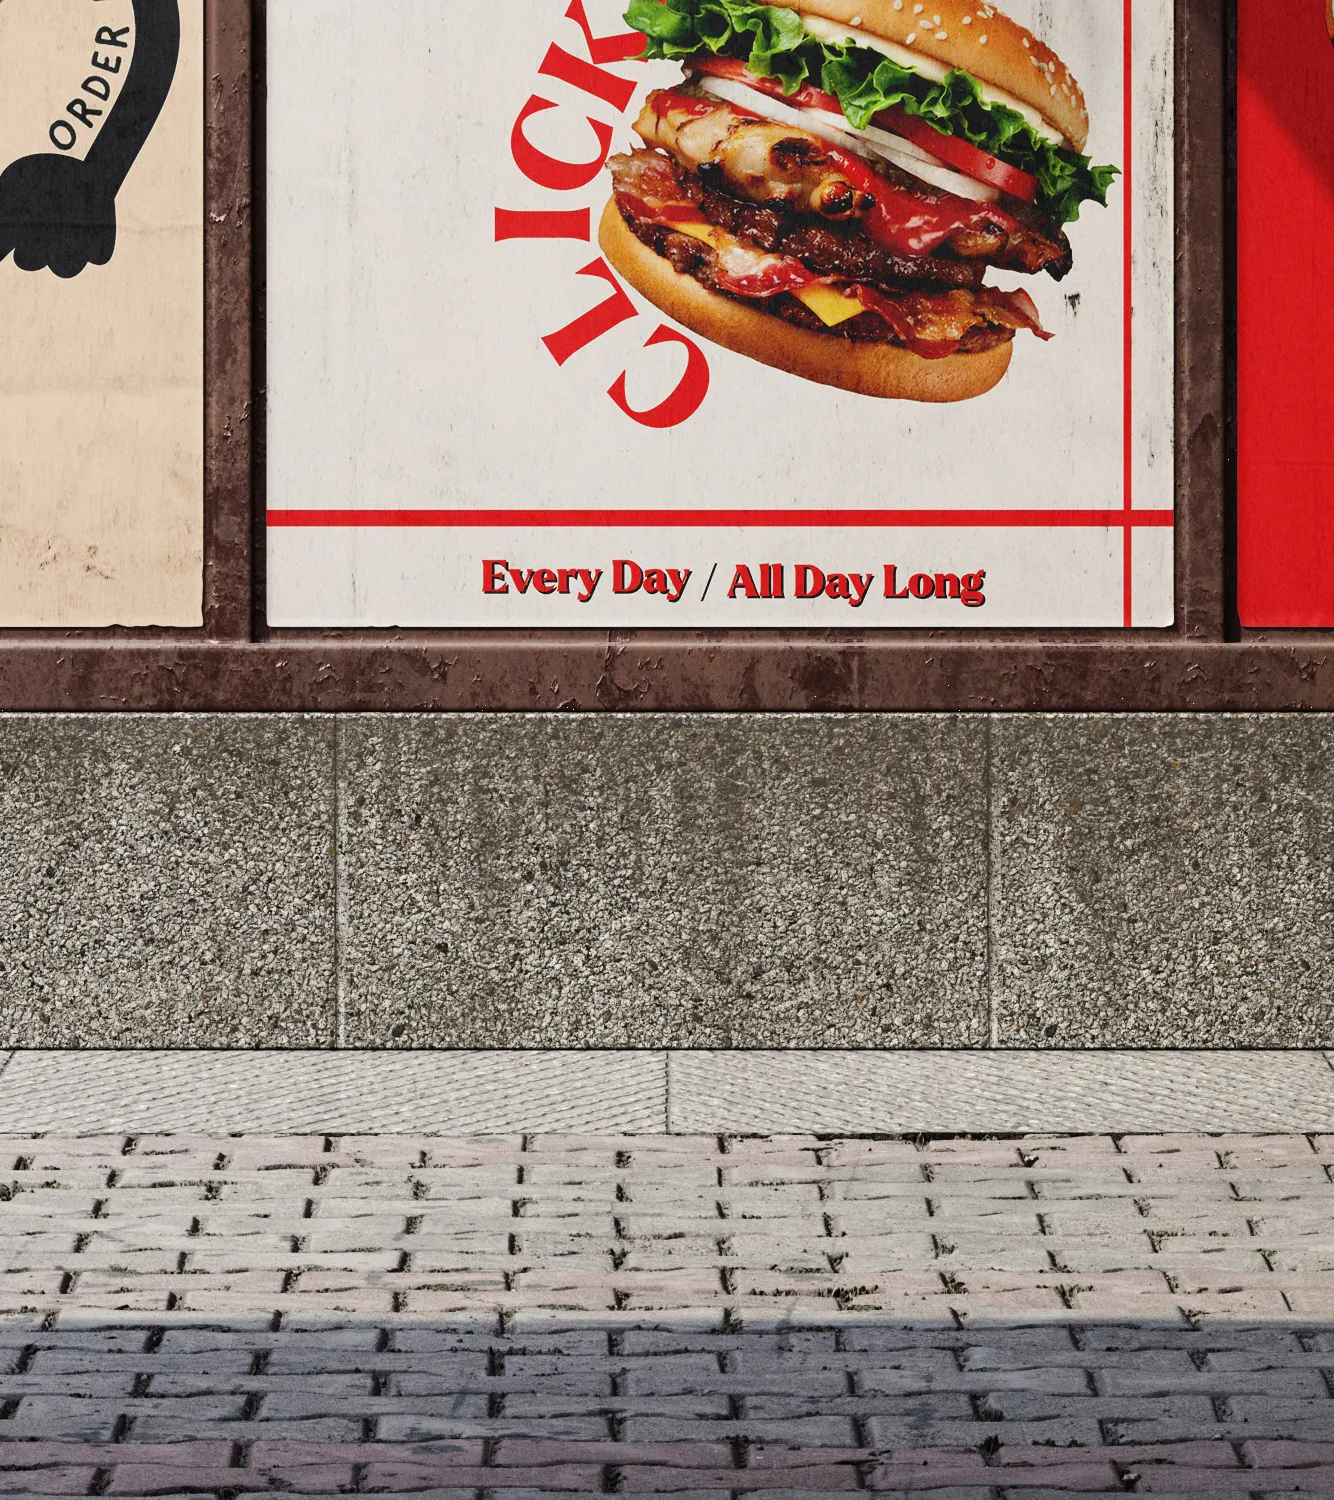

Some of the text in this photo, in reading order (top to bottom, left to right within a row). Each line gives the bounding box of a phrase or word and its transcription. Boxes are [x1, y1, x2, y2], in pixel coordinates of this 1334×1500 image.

[49, 26, 130, 151] ORDER
[481, 559, 603, 603] Every
[612, 559, 693, 603] Day
[726, 562, 786, 599] All
[793, 563, 875, 608] Day
[882, 563, 987, 608] Long
